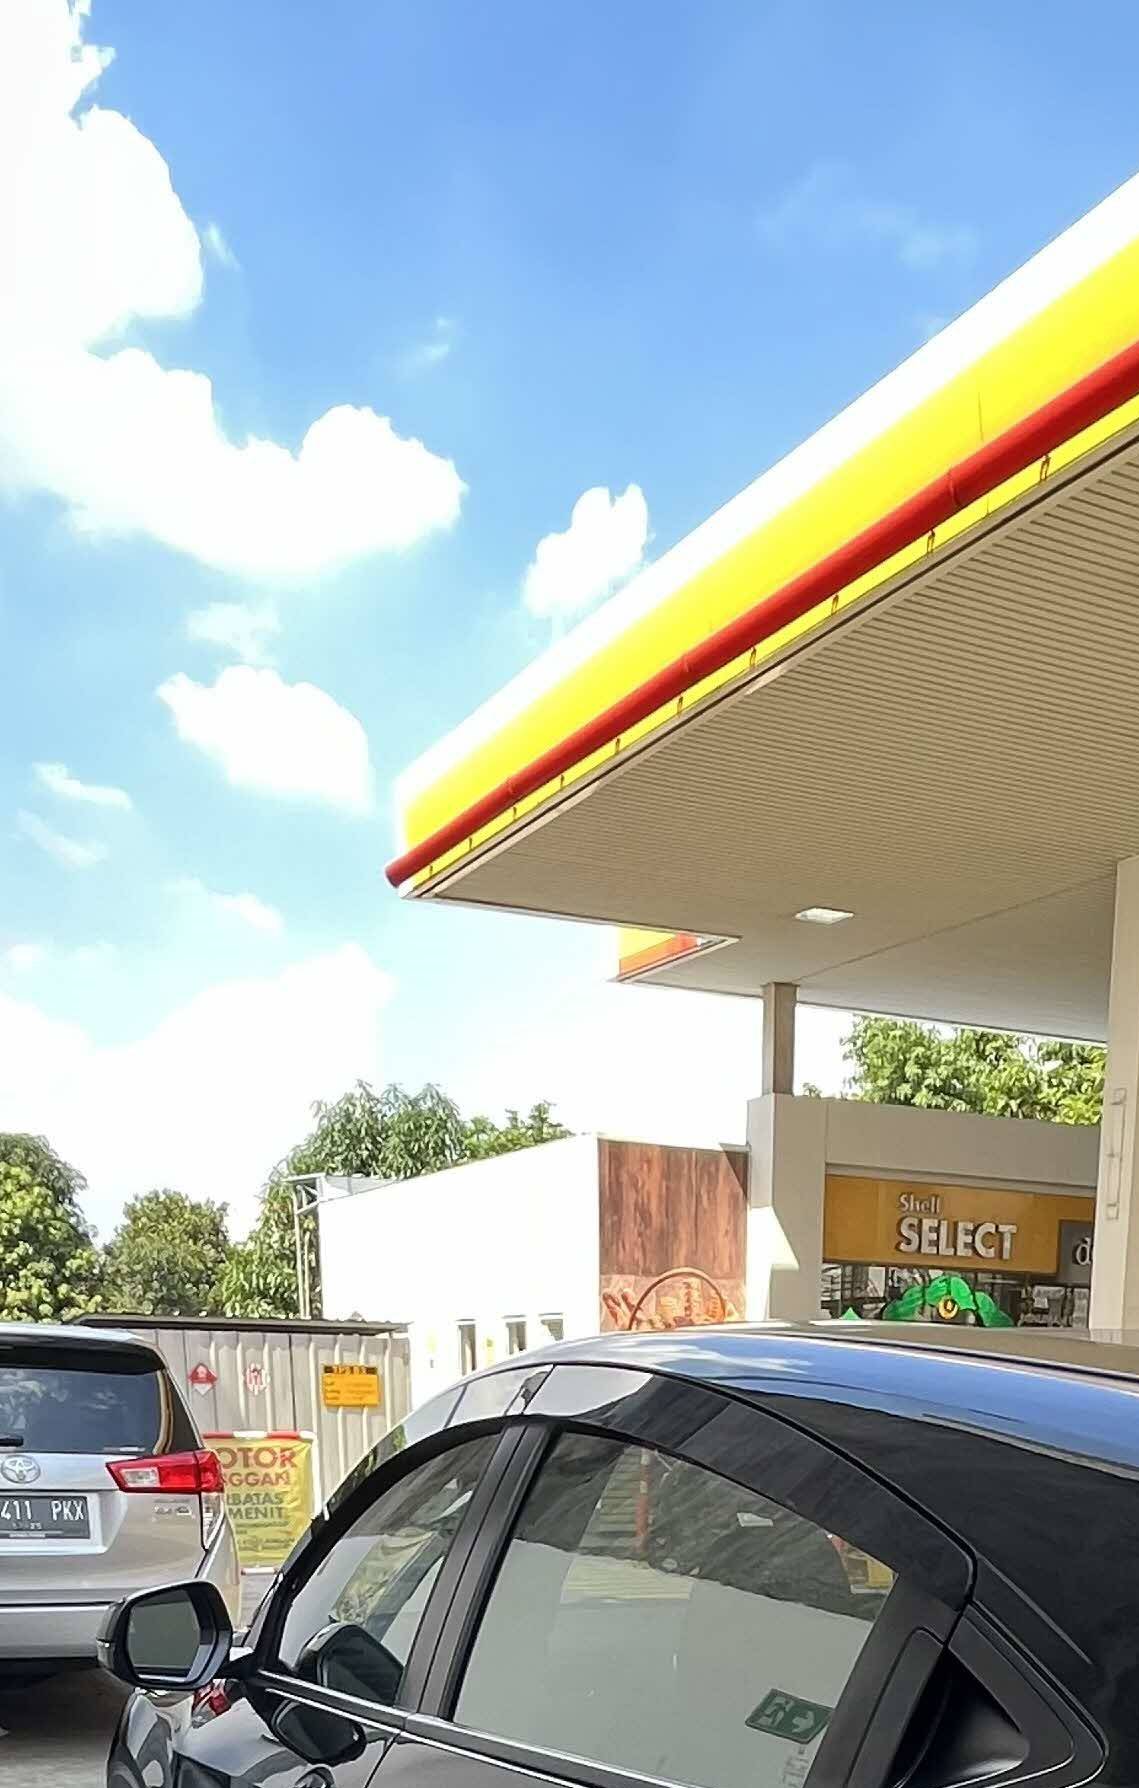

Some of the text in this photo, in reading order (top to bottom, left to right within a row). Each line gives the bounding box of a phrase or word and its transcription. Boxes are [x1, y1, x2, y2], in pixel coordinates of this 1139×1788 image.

[899, 1193, 941, 1215] Shell
[898, 1216, 1018, 1261] SELECT
[216, 1447, 298, 1469] OTOR
[51, 1500, 84, 1521] PKX
